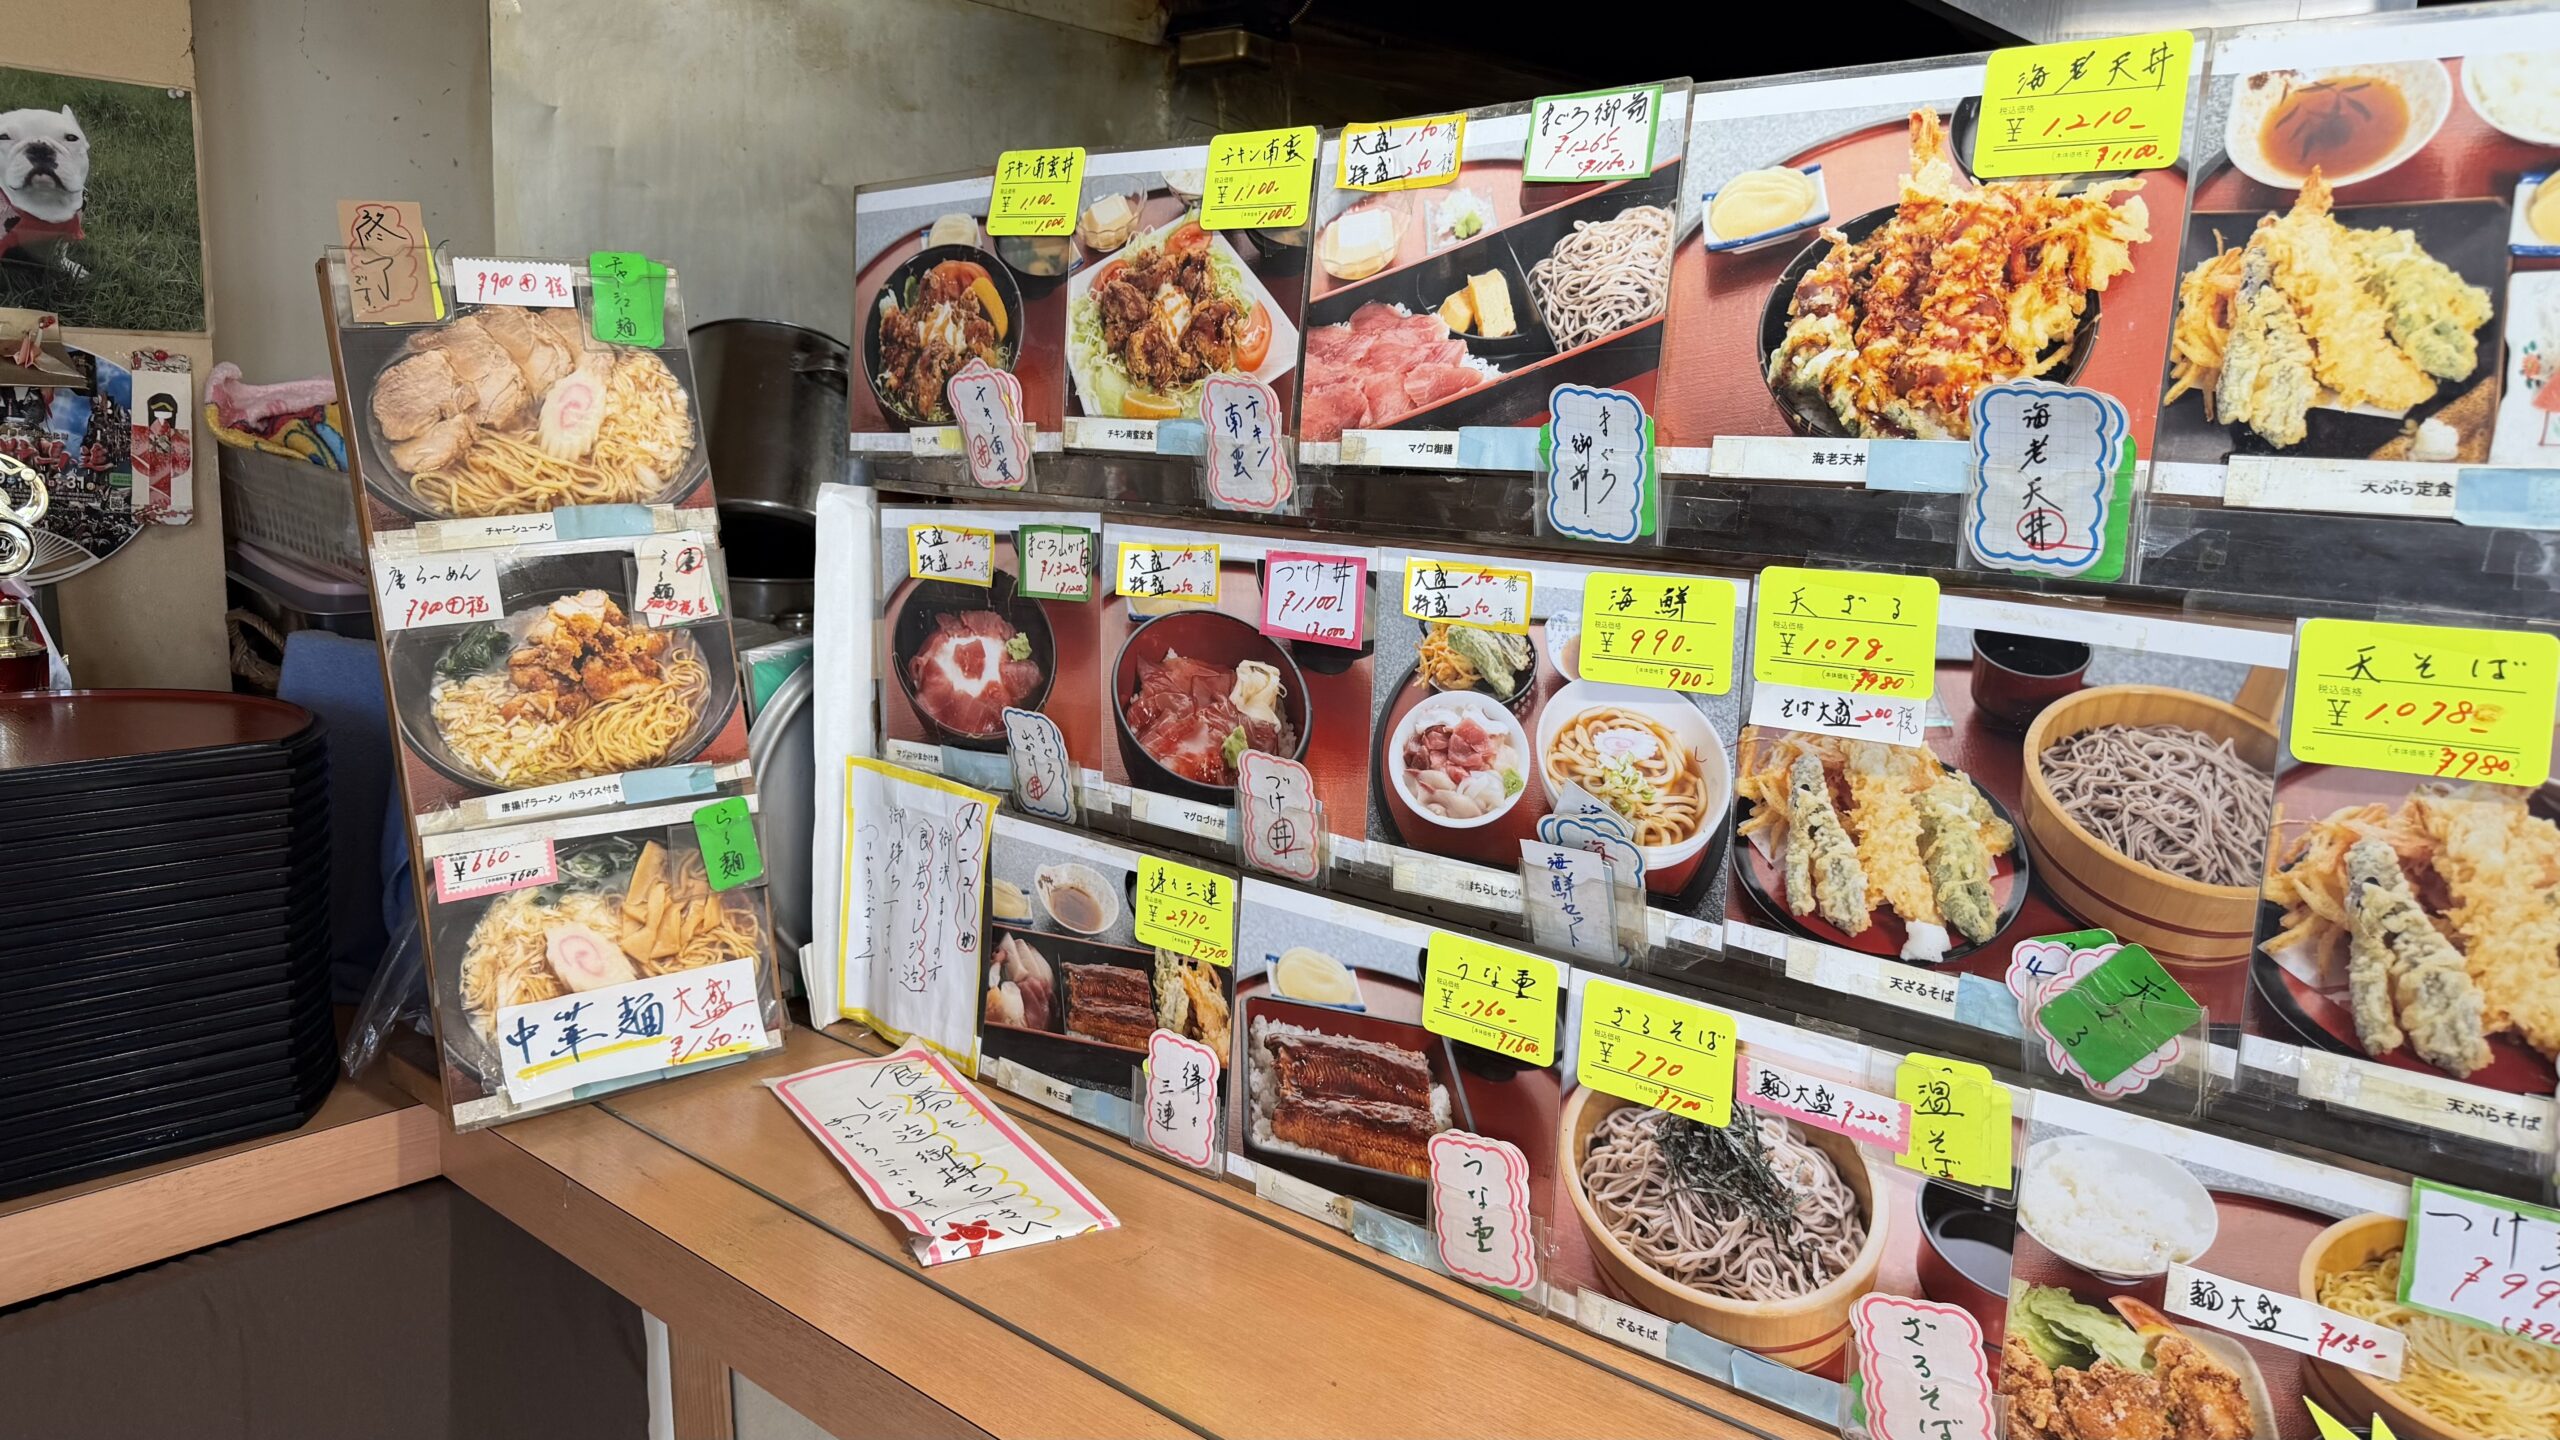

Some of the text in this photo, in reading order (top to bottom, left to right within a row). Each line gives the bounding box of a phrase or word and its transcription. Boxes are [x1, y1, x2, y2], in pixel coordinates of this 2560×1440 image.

[1408, 443, 1453, 455] マグロ御膳
[1811, 452, 1866, 467] 海老天丼
[485, 523, 553, 535] チャーシューメン
[2346, 646, 2527, 683] 天そば
[2318, 684, 2362, 697] 税込価格
[501, 783, 620, 813] 唐揚げラーメン 小ライス付き
[1184, 812, 1225, 827] マグロづけ丼
[1889, 976, 1955, 1003] 天ざるそば
[2447, 1097, 2542, 1131] 天ぷらそば
[2426, 1212, 2560, 1271] つけ
[1616, 1316, 1659, 1342] ざるそば
